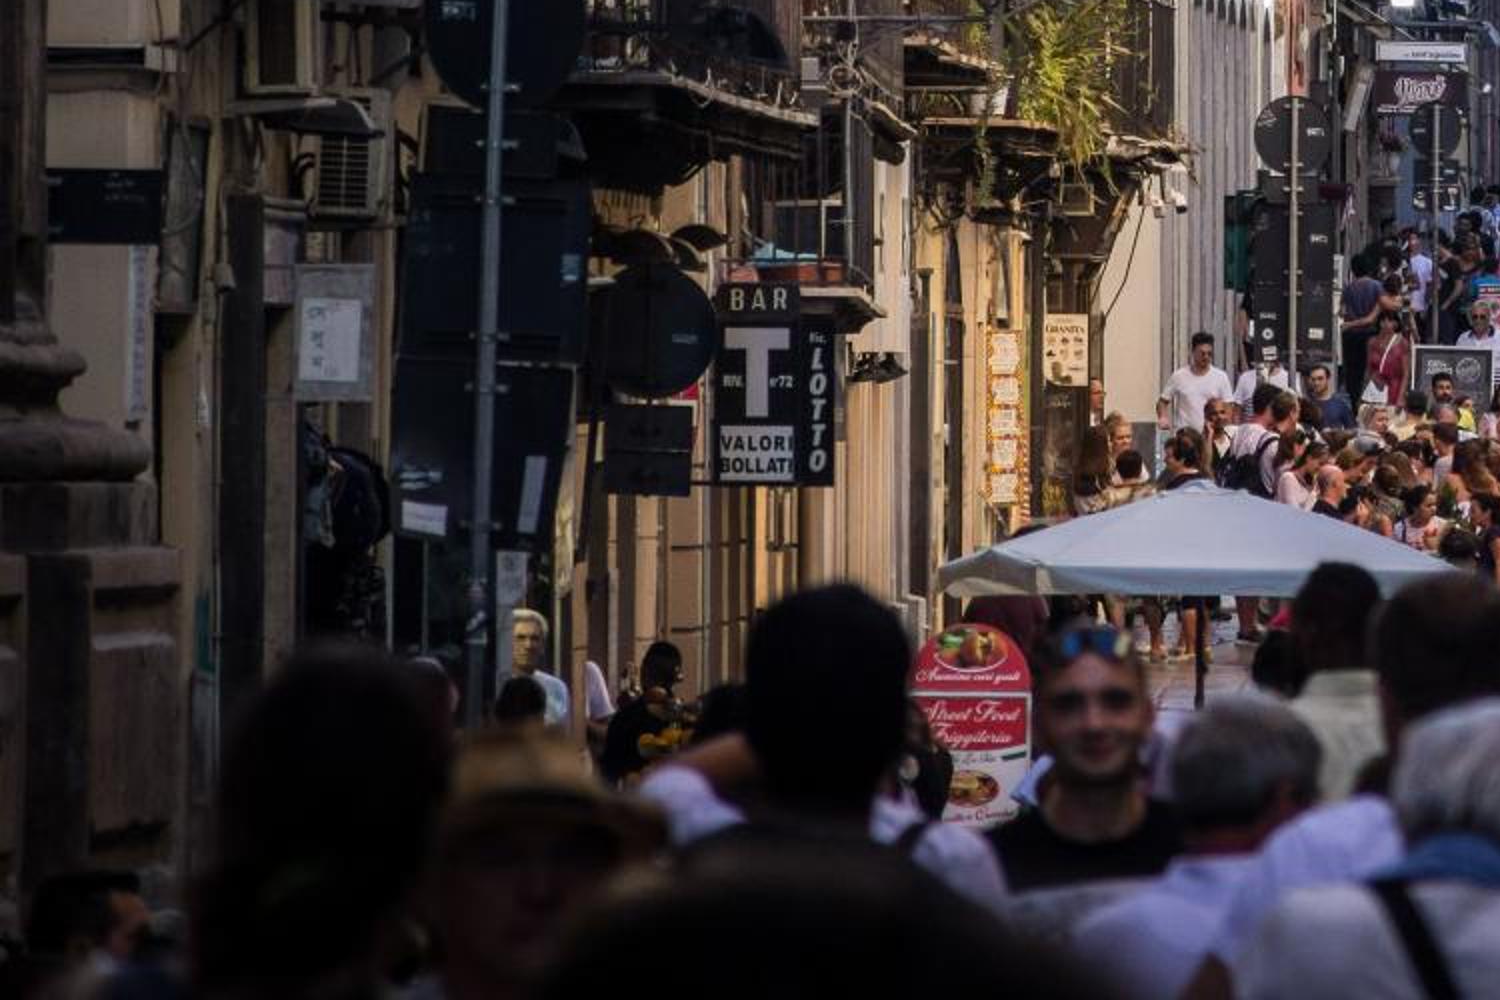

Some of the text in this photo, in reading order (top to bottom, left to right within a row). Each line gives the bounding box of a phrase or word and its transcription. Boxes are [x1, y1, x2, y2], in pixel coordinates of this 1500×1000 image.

[730, 287, 788, 311] BAR
[725, 327, 790, 418] T
[809, 347, 827, 473] LOTTO
[720, 435, 793, 452] VALORI
[720, 457, 793, 475] BOLLATI
[973, 700, 1021, 722] Food
